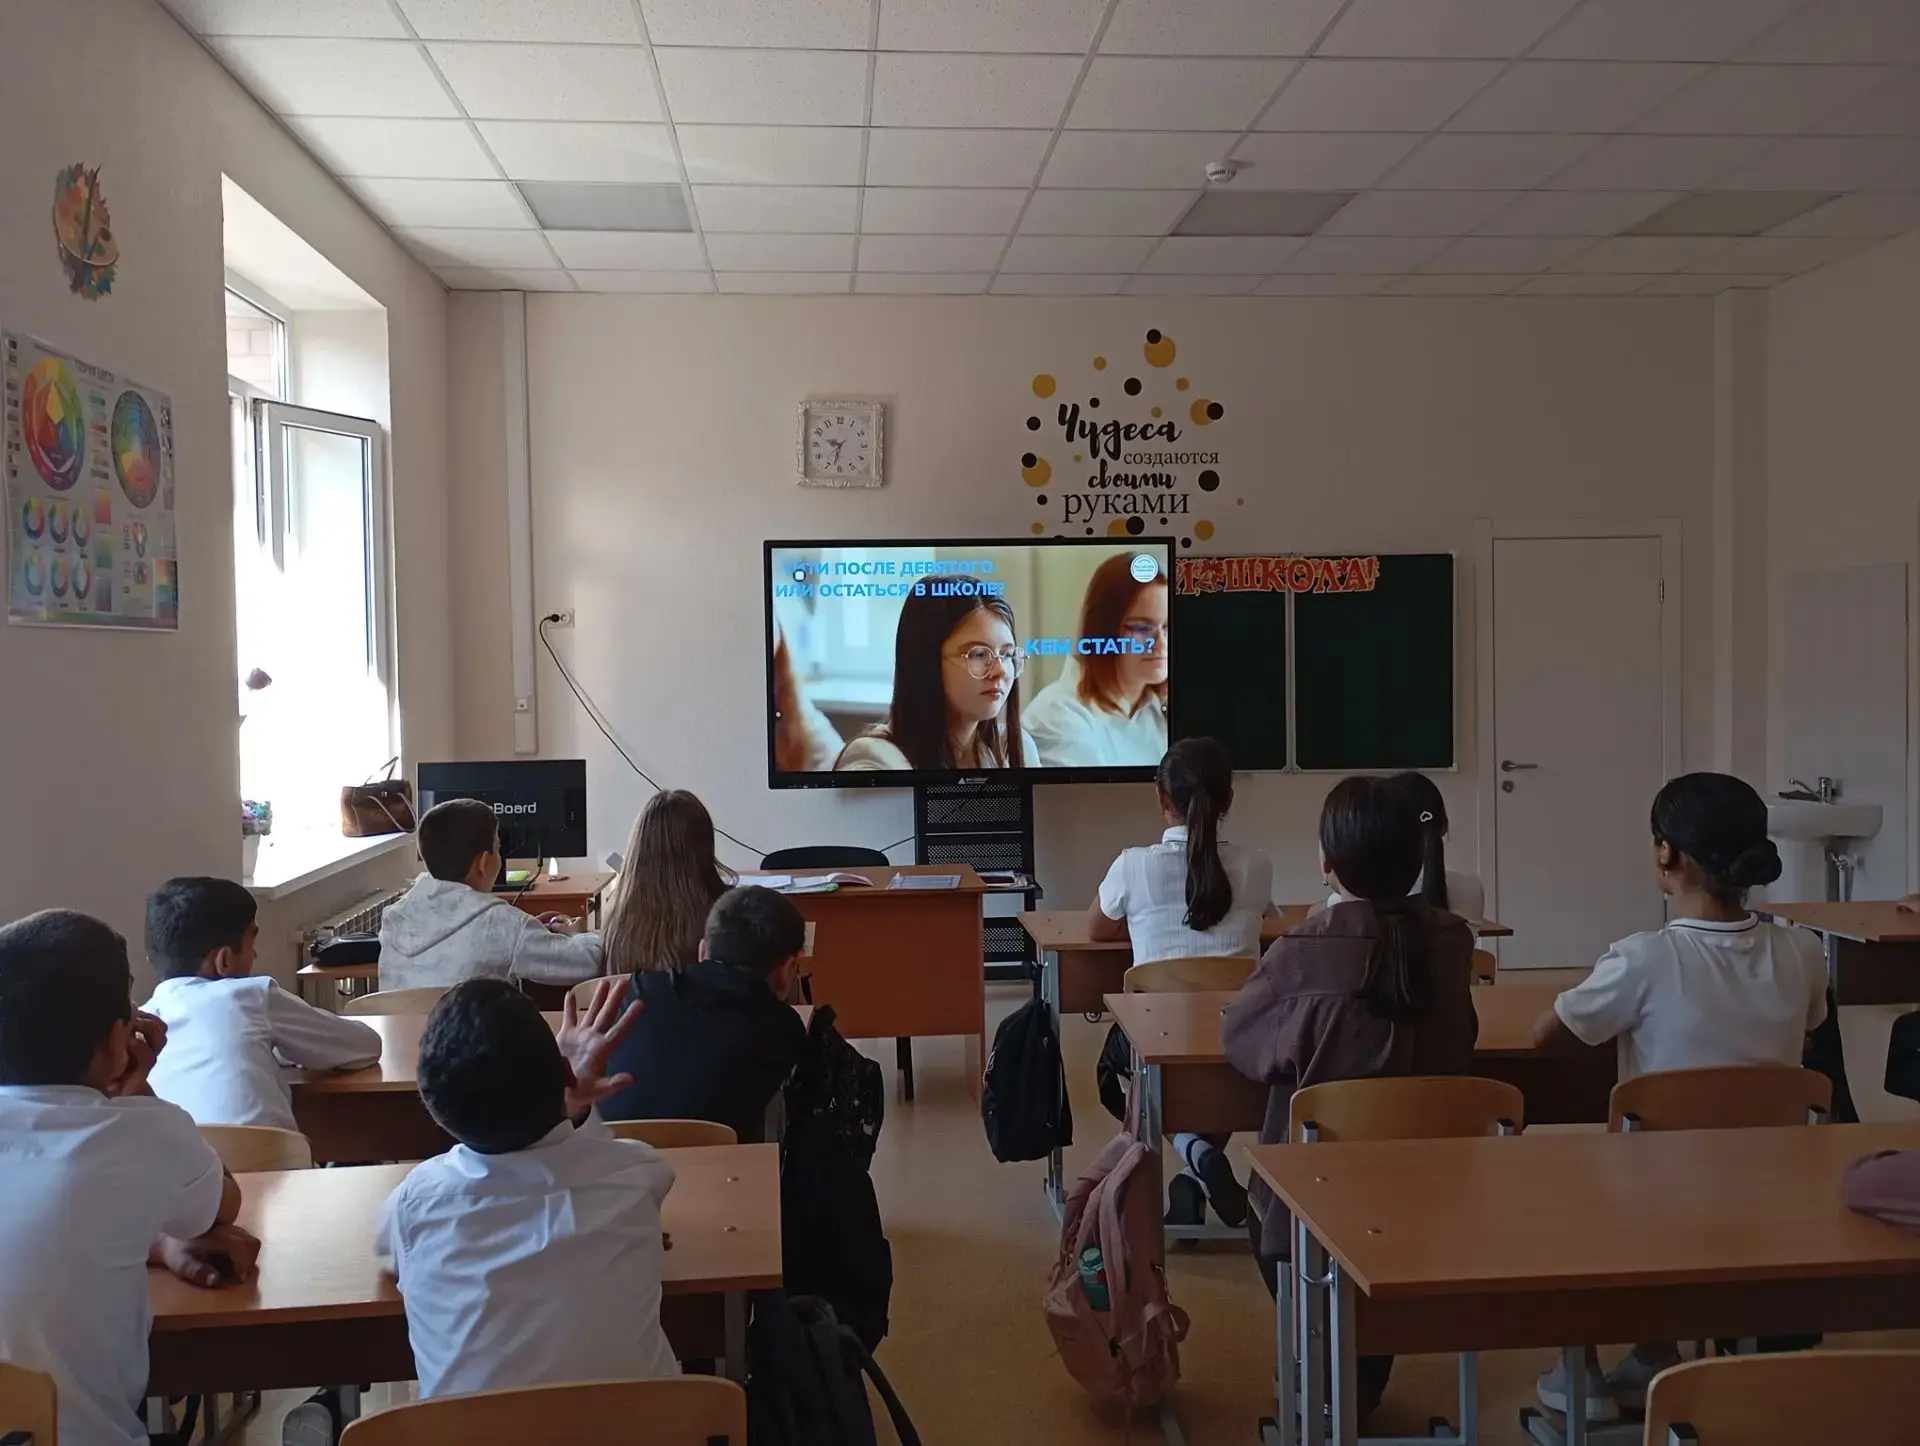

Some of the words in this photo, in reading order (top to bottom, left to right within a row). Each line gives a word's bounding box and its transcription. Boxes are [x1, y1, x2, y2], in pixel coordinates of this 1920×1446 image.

[1058, 403, 1182, 461] Чудеса
[1123, 452, 1219, 467] создаются
[1088, 459, 1177, 489] своими
[1062, 493, 1190, 524] руками
[834, 561, 896, 576] ПОСЛЕ
[900, 560, 995, 578] ДЕВЯТОГО
[775, 584, 814, 598] ИЛИ
[819, 583, 910, 598] ОСТАТЬСЯ
[914, 582, 927, 597] В
[1024, 638, 1071, 656] КЕМ
[1077, 637, 1155, 655] СТАТЬ?
